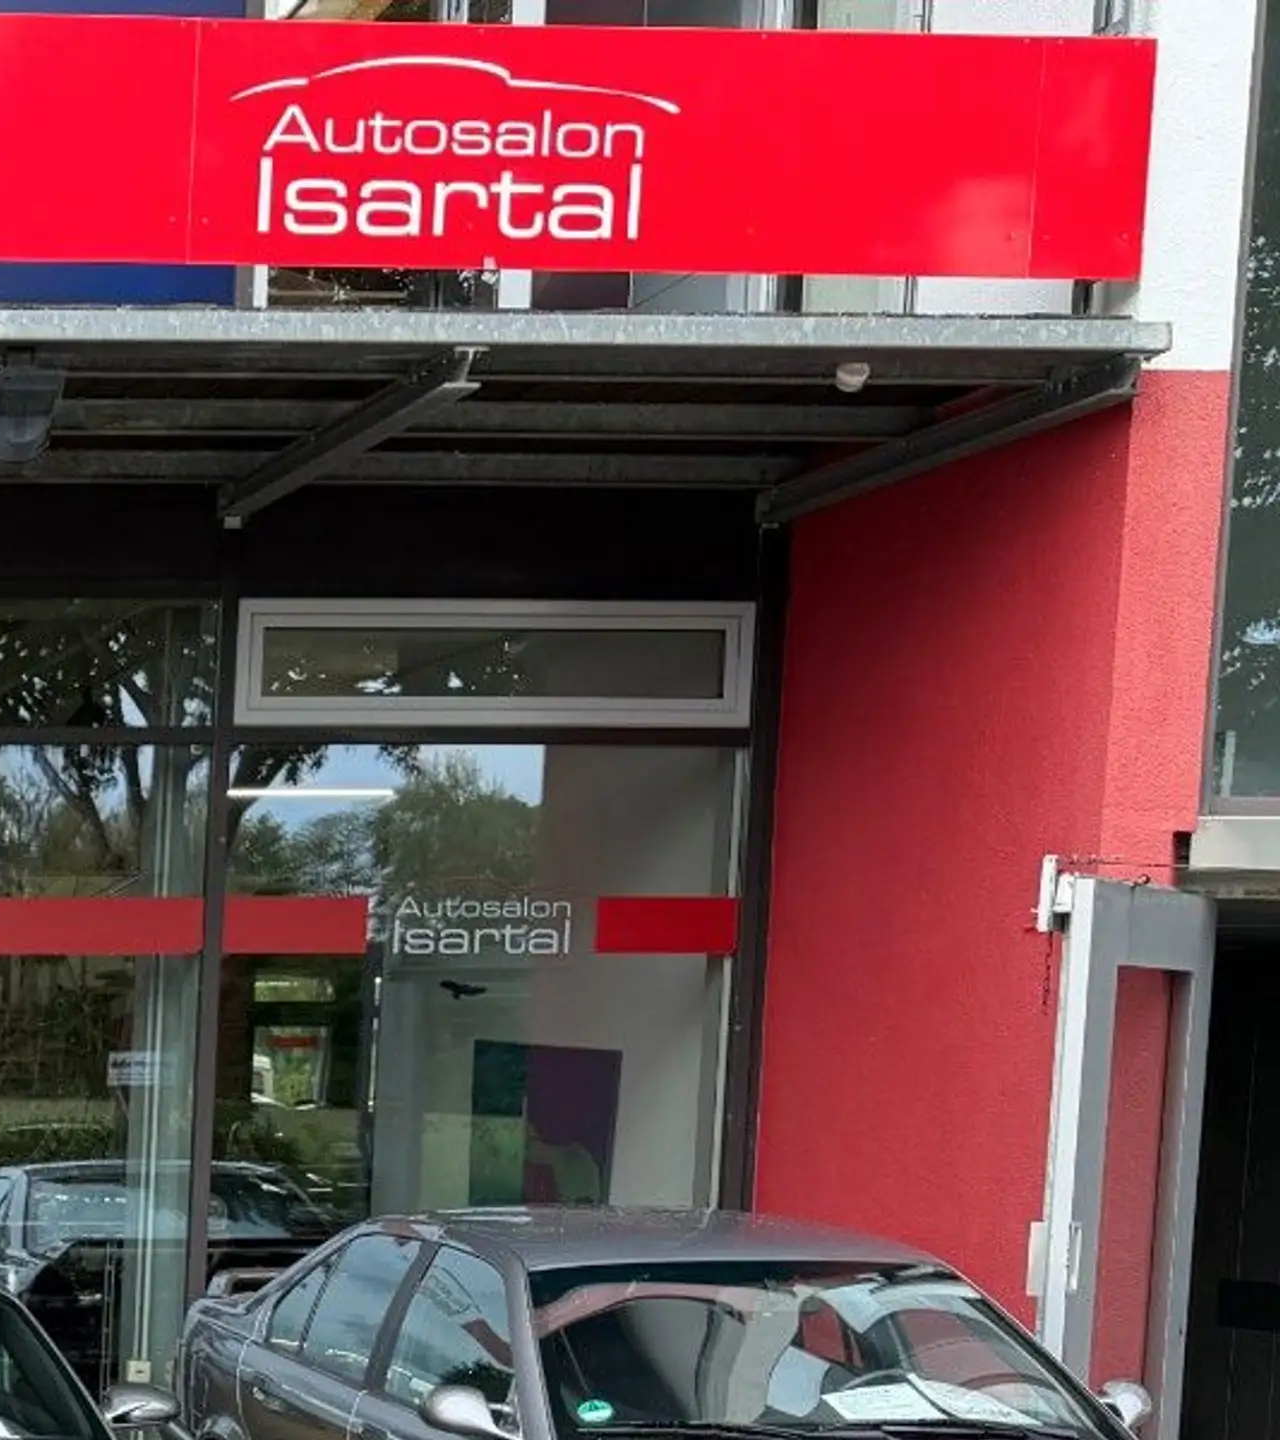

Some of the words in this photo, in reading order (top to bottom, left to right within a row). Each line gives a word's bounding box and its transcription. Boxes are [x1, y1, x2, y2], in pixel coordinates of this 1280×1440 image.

[262, 104, 645, 158] Autosalon
[256, 156, 643, 241] Isartal
[395, 894, 572, 919] Autosalon
[391, 917, 572, 956] Isartal
